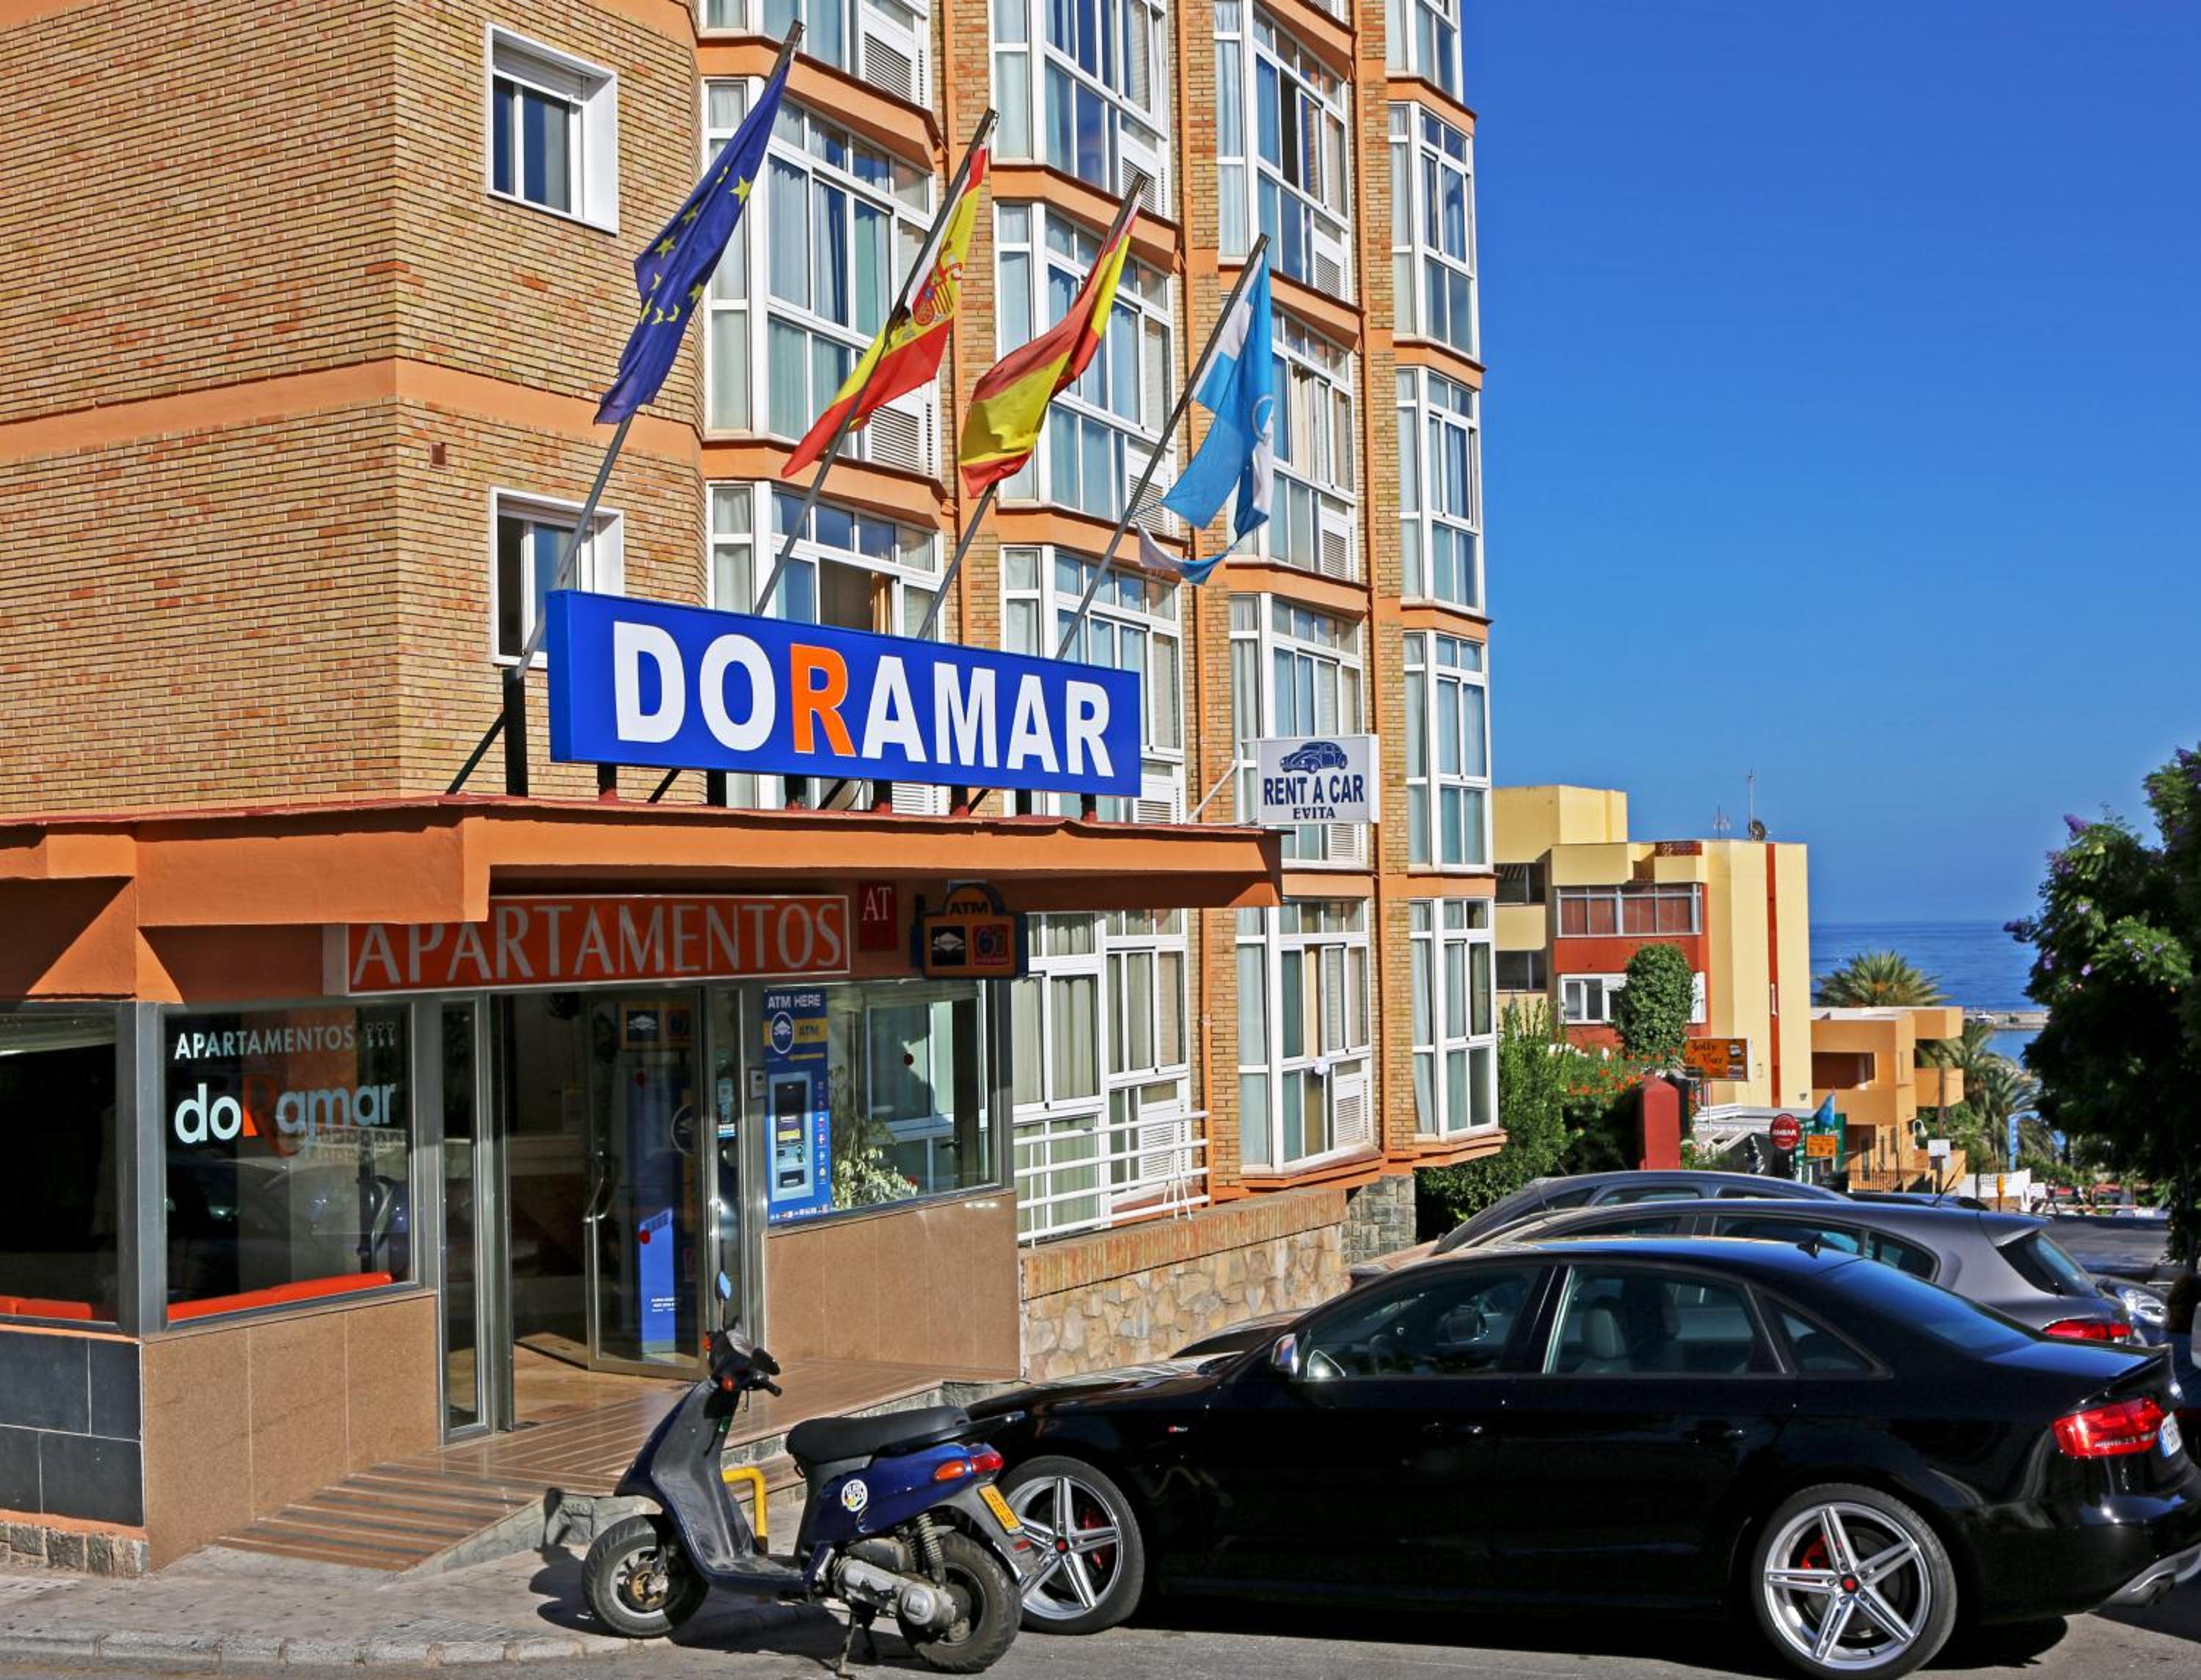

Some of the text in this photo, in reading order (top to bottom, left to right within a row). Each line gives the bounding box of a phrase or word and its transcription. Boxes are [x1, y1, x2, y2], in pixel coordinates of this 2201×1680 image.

[613, 621, 1114, 778] DORAMAR
[1263, 775, 1364, 806] RENT A CAR
[1293, 806, 1335, 819] EVITA
[863, 886, 892, 921] AT
[949, 901, 988, 915] ATM
[352, 903, 843, 985] APARTAMENTOS
[767, 994, 821, 1009] ATM HERE
[174, 1026, 355, 1060] APARTAMENTOS
